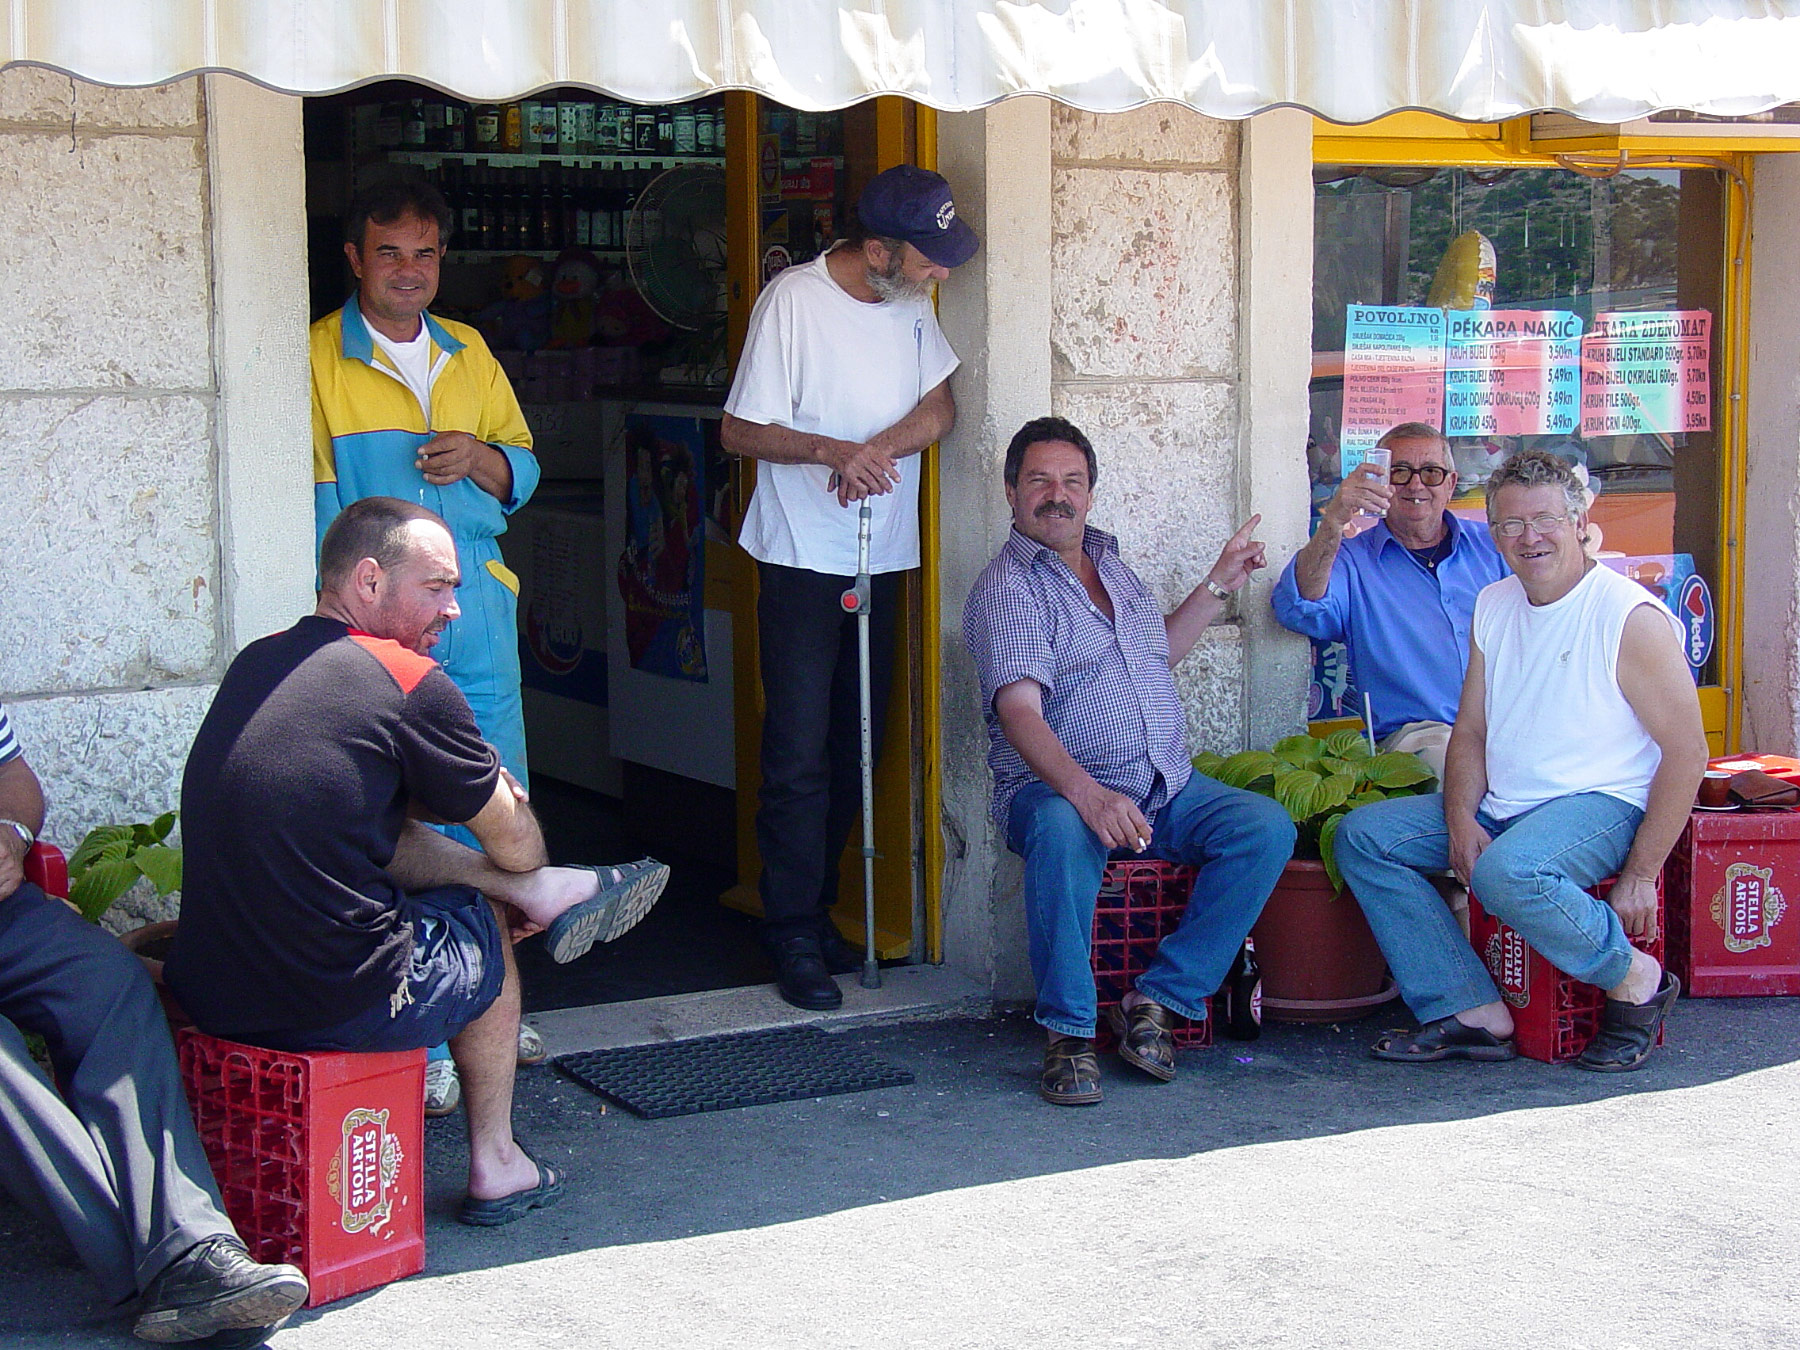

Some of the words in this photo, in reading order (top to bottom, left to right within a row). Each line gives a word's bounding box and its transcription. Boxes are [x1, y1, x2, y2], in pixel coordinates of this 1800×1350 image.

[1354, 311, 1440, 325] POVOLJNO
[1523, 315, 1575, 338] NAKIĆ
[1588, 320, 1638, 339] EKARA
[1641, 319, 1706, 337] ZDENOMAT
[1450, 345, 1467, 360] KRUH
[1469, 345, 1488, 360] BIJELI
[1548, 344, 1573, 361] 3,50kn
[1606, 347, 1626, 362] BIJELI
[1627, 346, 1664, 362] STANDARD
[1687, 346, 1707, 362] 5,70kn
[1449, 370, 1468, 384] KRUH
[1469, 370, 1488, 383] BIJELI
[1488, 369, 1505, 386] 600g
[1547, 368, 1573, 384] 5,49kn
[1605, 370, 1626, 384] BIJELI
[1627, 369, 1658, 384] OKRUGLI
[1449, 392, 1468, 406] KRUH
[1546, 391, 1573, 407] 5,49kn
[1605, 393, 1619, 408] FILE
[1449, 416, 1468, 430] KRUH
[1468, 415, 1480, 430] BIO
[1481, 415, 1498, 433] 450g
[1545, 414, 1573, 431] 5,49kn
[1605, 416, 1620, 431] CRNI
[1686, 413, 1707, 430] 3,95kn
[1735, 881, 1747, 935] ARTOIS
[1747, 881, 1759, 933] STELLA
[1504, 931, 1513, 986] STELLA
[352, 1134, 364, 1208] ARTOIS
[364, 1129, 376, 1204] STELLA
